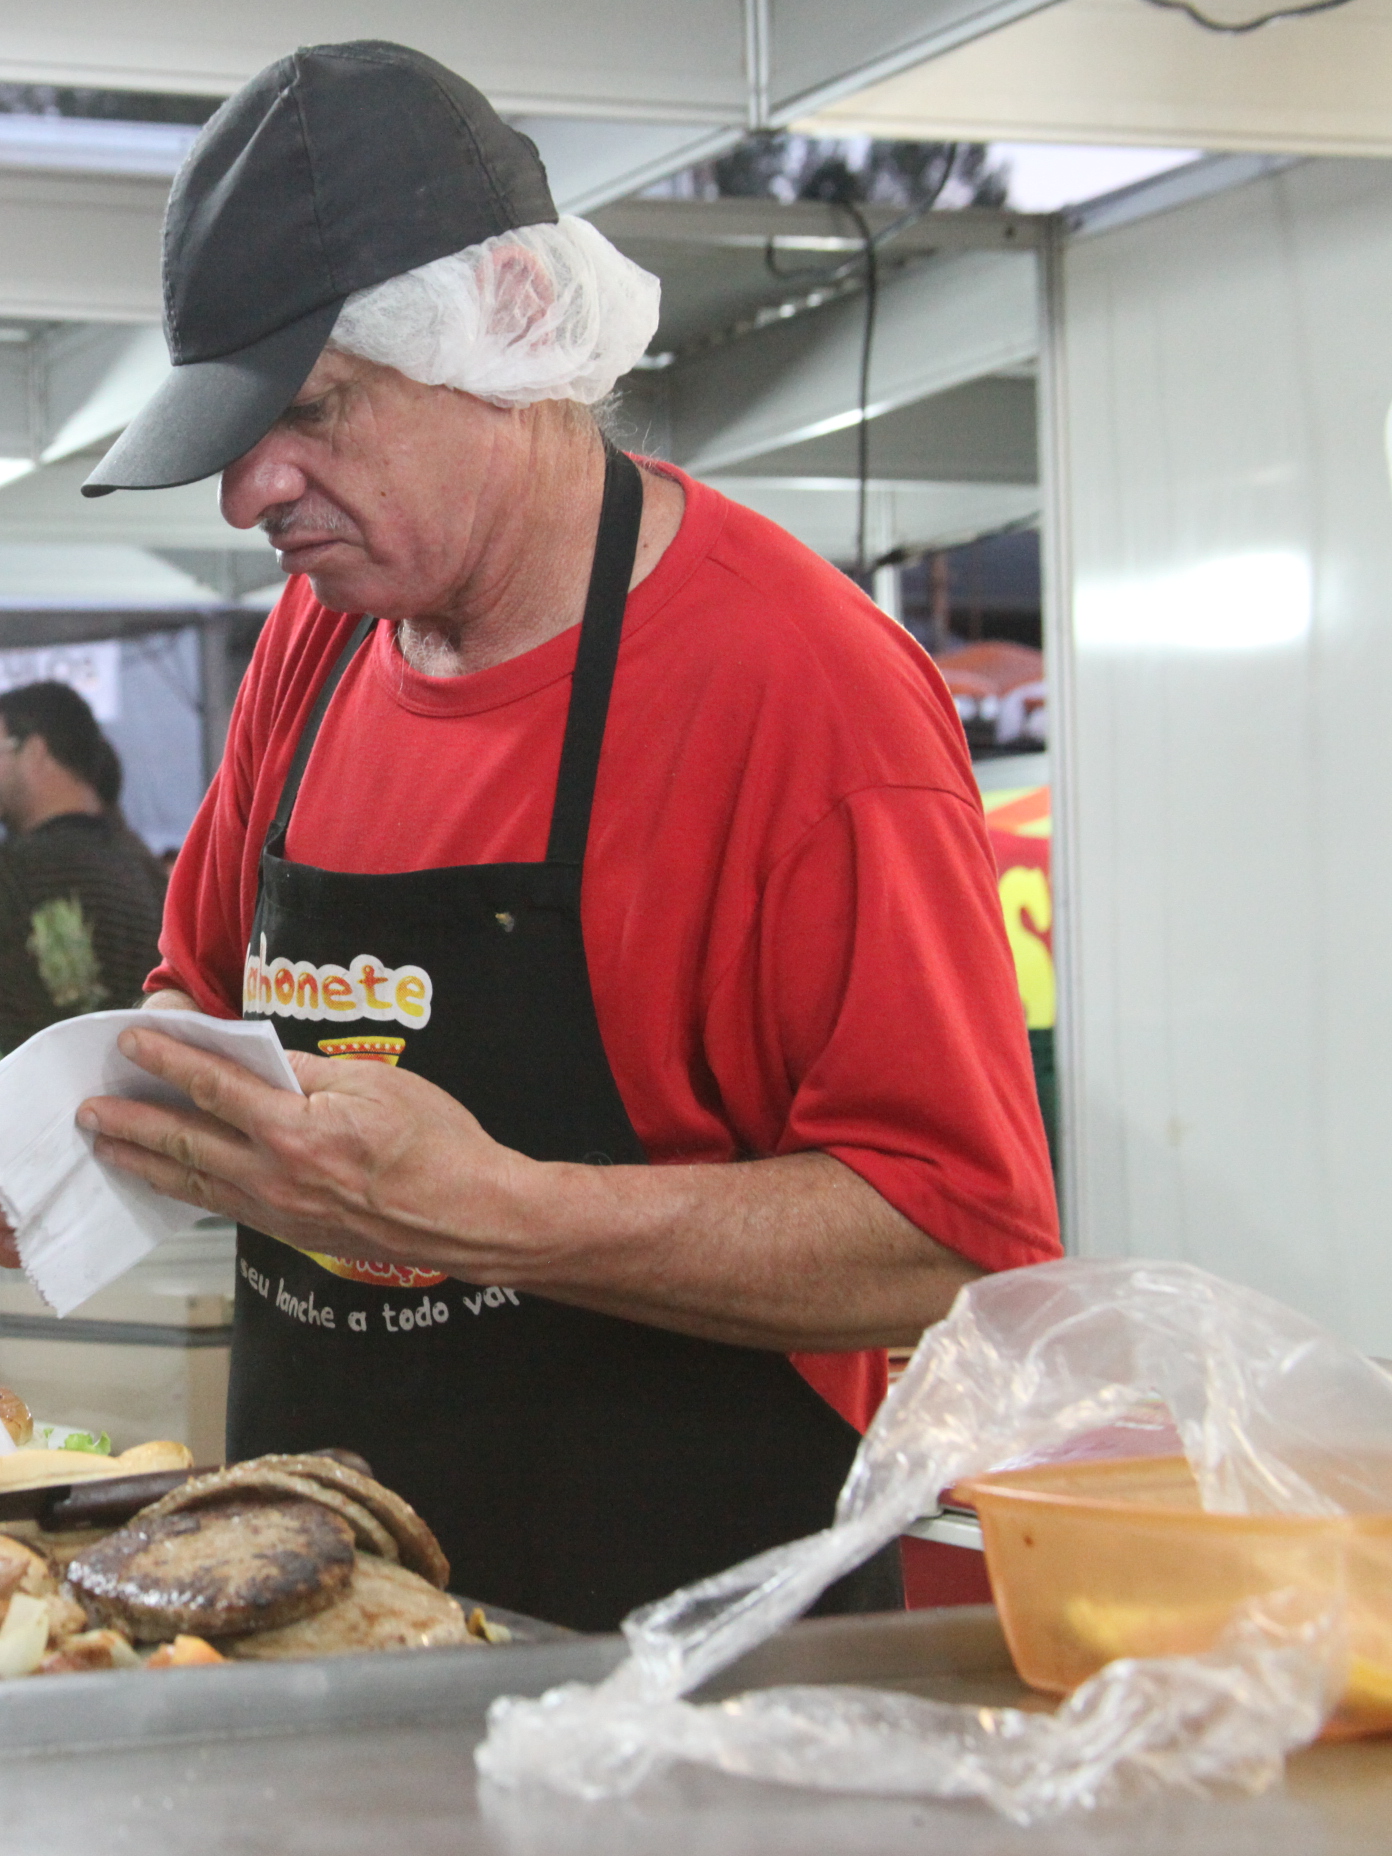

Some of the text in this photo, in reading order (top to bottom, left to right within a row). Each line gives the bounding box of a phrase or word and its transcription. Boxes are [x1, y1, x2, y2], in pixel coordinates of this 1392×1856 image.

[240, 1258, 270, 1298] seu
[276, 1278, 336, 1329] lanche
[348, 1310, 367, 1332] a
[383, 1296, 449, 1332] todo
